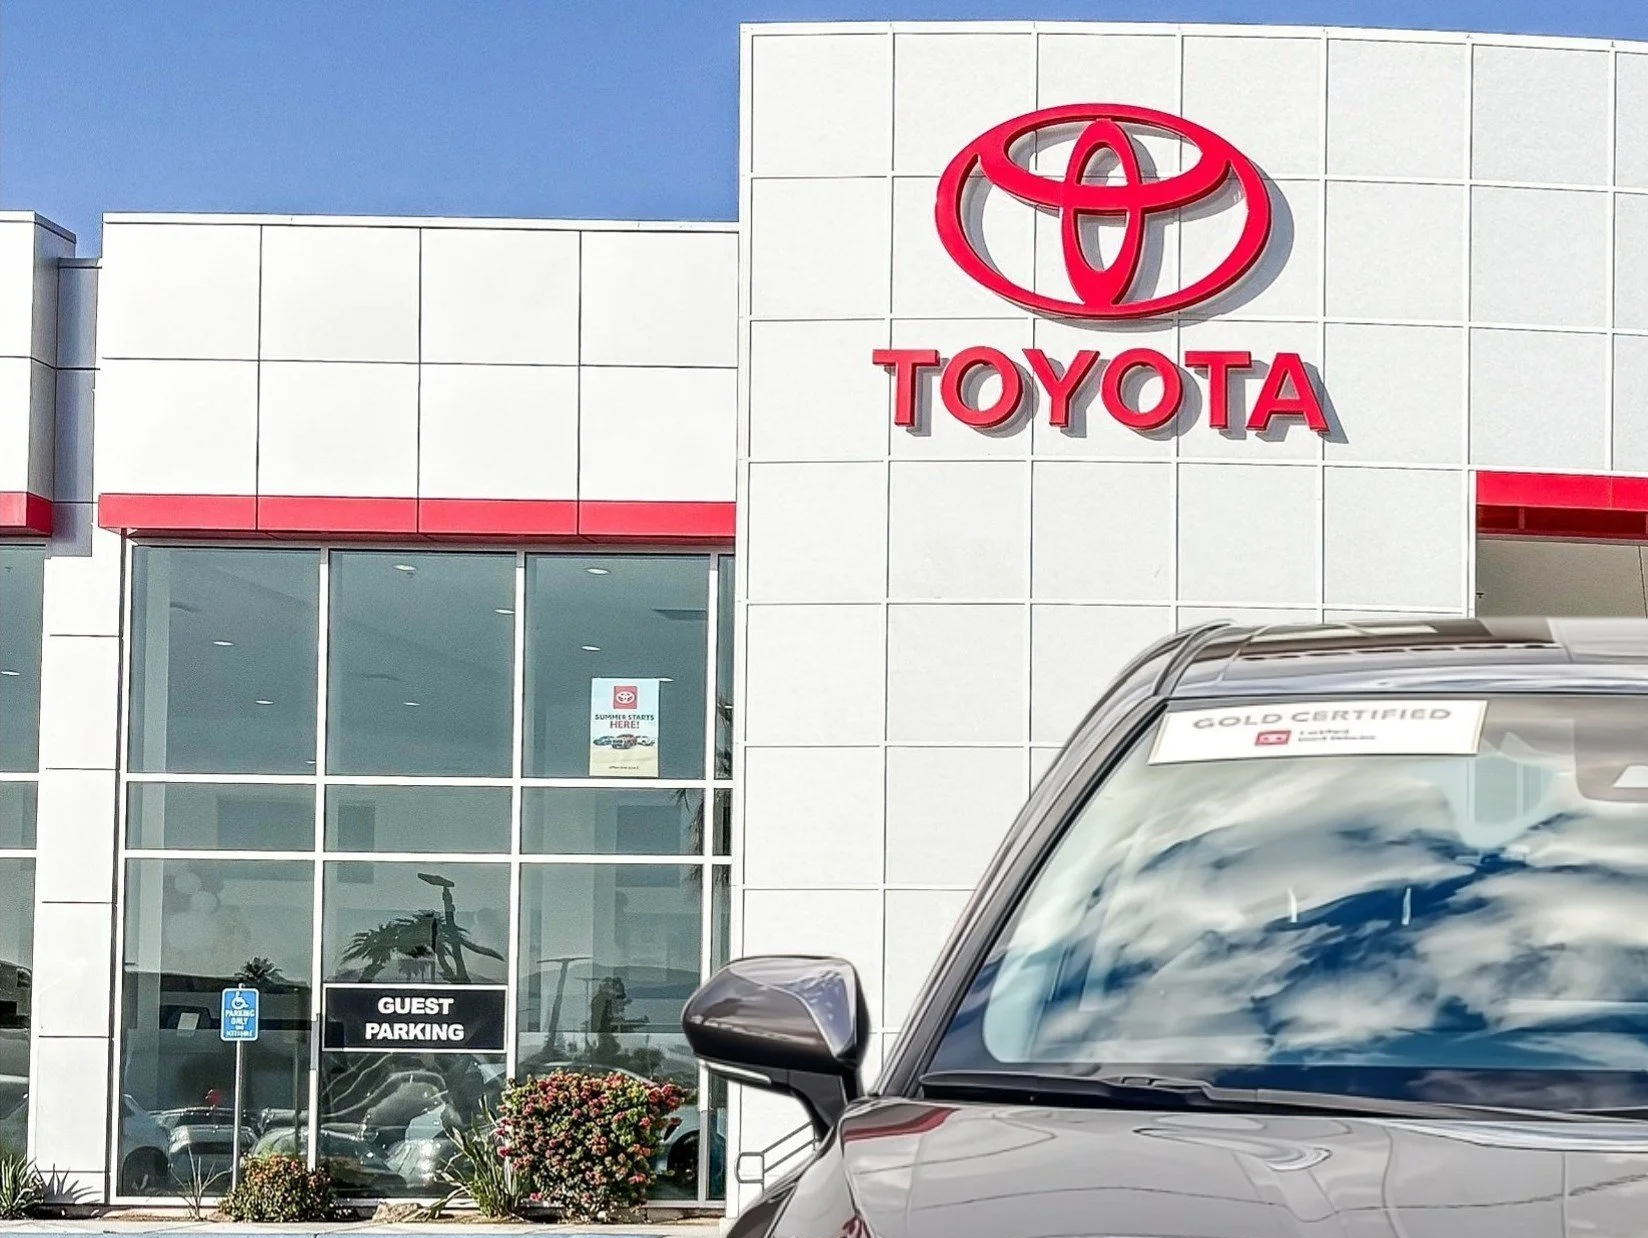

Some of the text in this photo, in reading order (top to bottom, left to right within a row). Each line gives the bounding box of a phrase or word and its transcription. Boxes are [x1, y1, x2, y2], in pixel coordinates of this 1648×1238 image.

[872, 345, 1330, 432] TOYOTA
[594, 713, 655, 721] SUMMER STARTS
[609, 720, 640, 730] HERE!
[1192, 707, 1452, 730] GOLD CERTIFIED
[377, 997, 455, 1015] GUEST
[365, 1022, 465, 1041] PARKING
